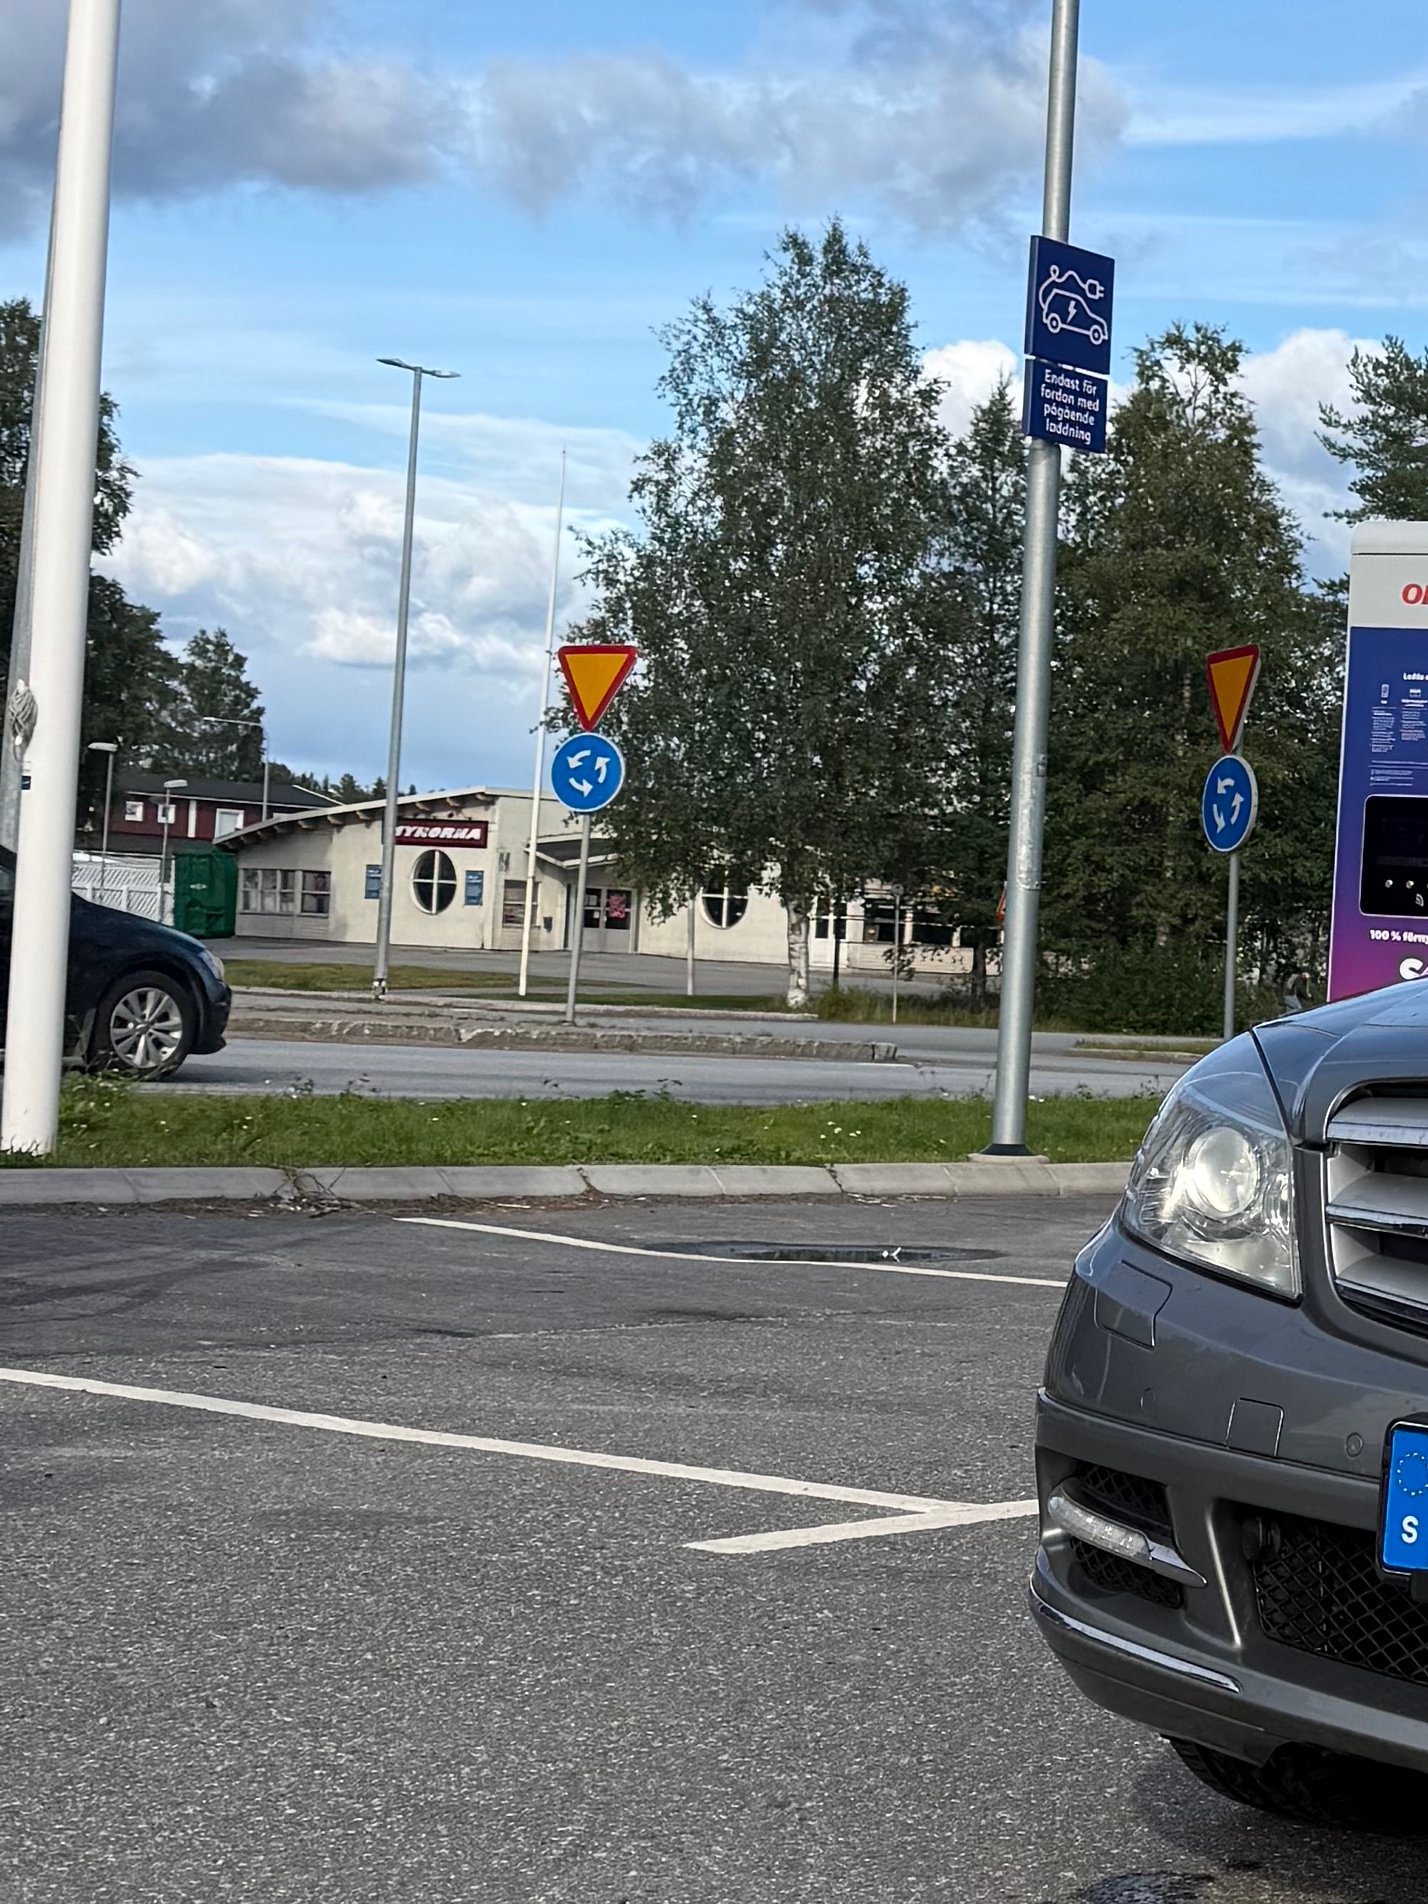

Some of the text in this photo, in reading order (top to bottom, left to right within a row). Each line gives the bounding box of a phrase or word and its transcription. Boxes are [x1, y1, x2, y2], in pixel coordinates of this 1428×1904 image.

[1044, 368, 1097, 396] Endast för
[1041, 384, 1100, 412] fordon med
[1044, 402, 1095, 426] pågående
[1046, 418, 1091, 445] laddning
[1369, 929, 1390, 941] 100
[1390, 931, 1402, 942] %
[1401, 1516, 1419, 1544] S
